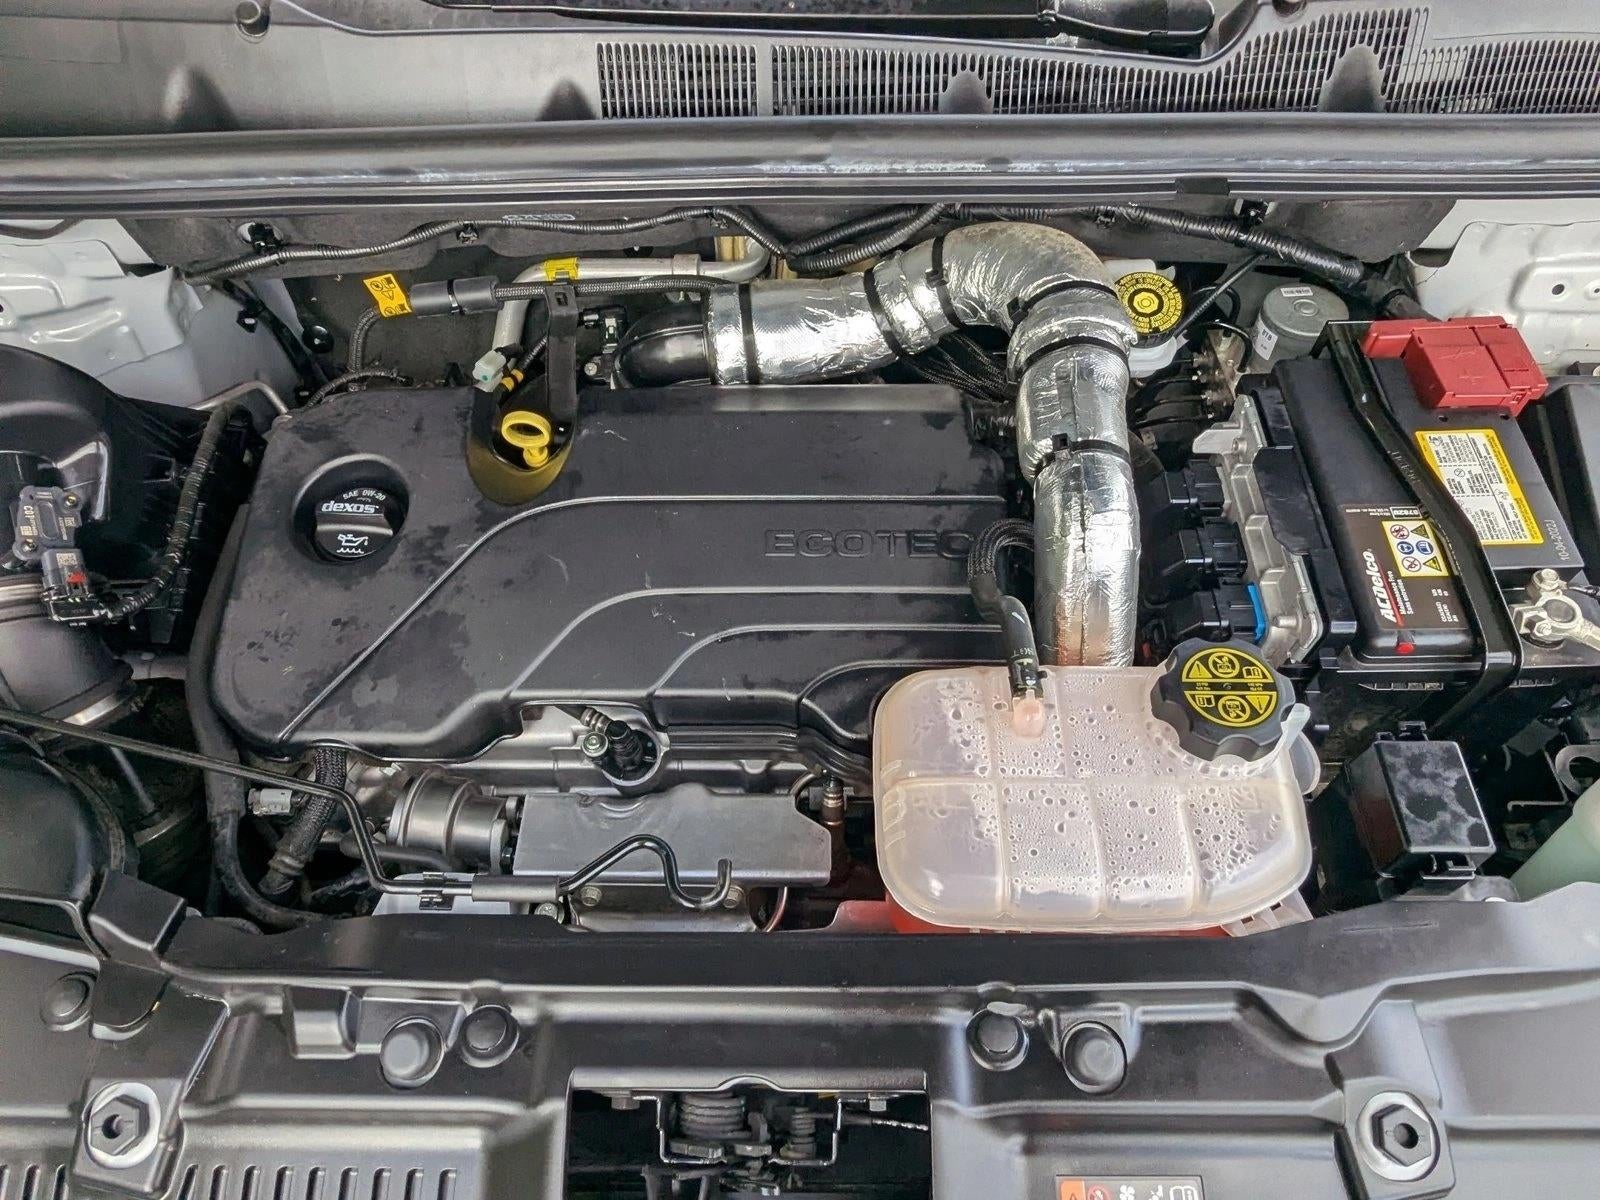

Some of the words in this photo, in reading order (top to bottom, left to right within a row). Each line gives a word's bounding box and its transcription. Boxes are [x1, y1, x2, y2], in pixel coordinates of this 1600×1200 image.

[342, 490, 359, 500] SAE
[362, 489, 386, 501] 0W-20
[321, 500, 376, 514] dexos
[764, 529, 975, 558] ECOTEC
[1362, 550, 1398, 623] ACDelco
